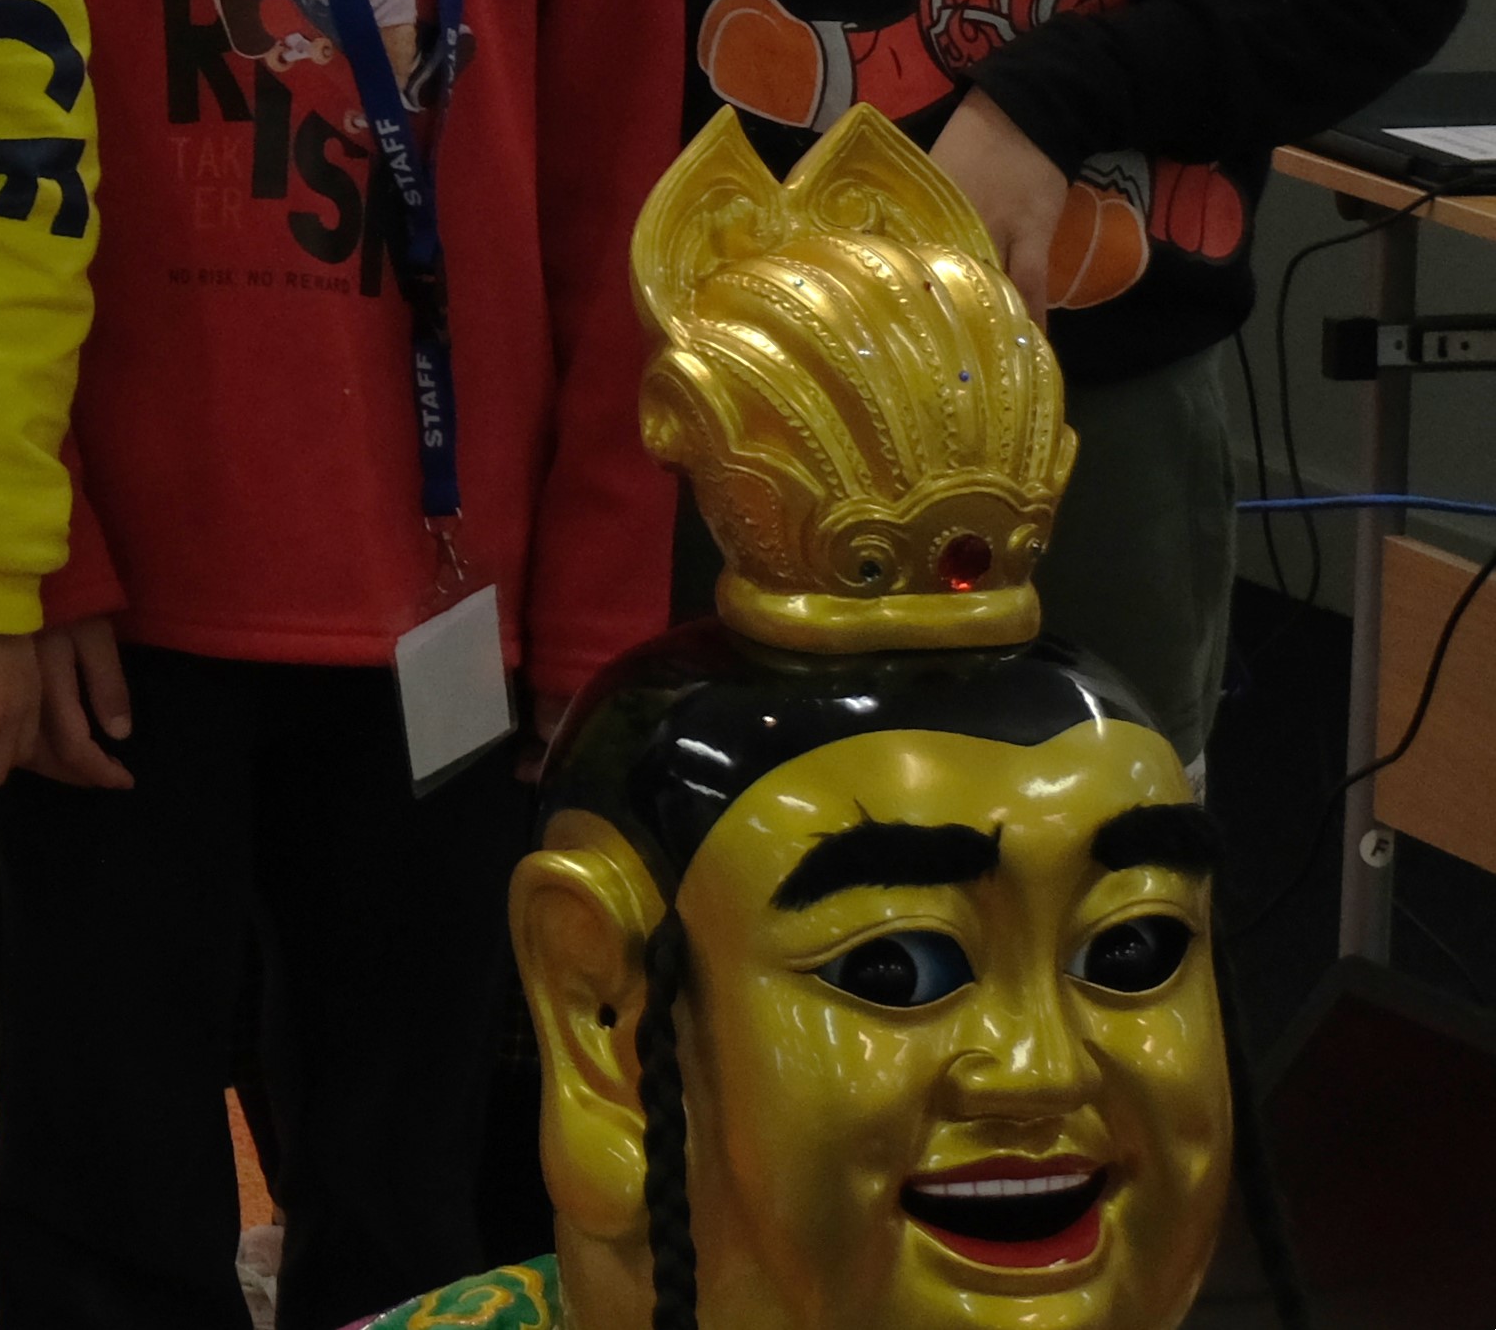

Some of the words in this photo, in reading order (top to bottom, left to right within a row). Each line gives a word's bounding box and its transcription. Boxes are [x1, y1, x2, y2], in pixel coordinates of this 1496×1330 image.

[375, 119, 423, 206] STAFF
[247, 271, 273, 287] NO
[415, 352, 444, 448] STAFF
